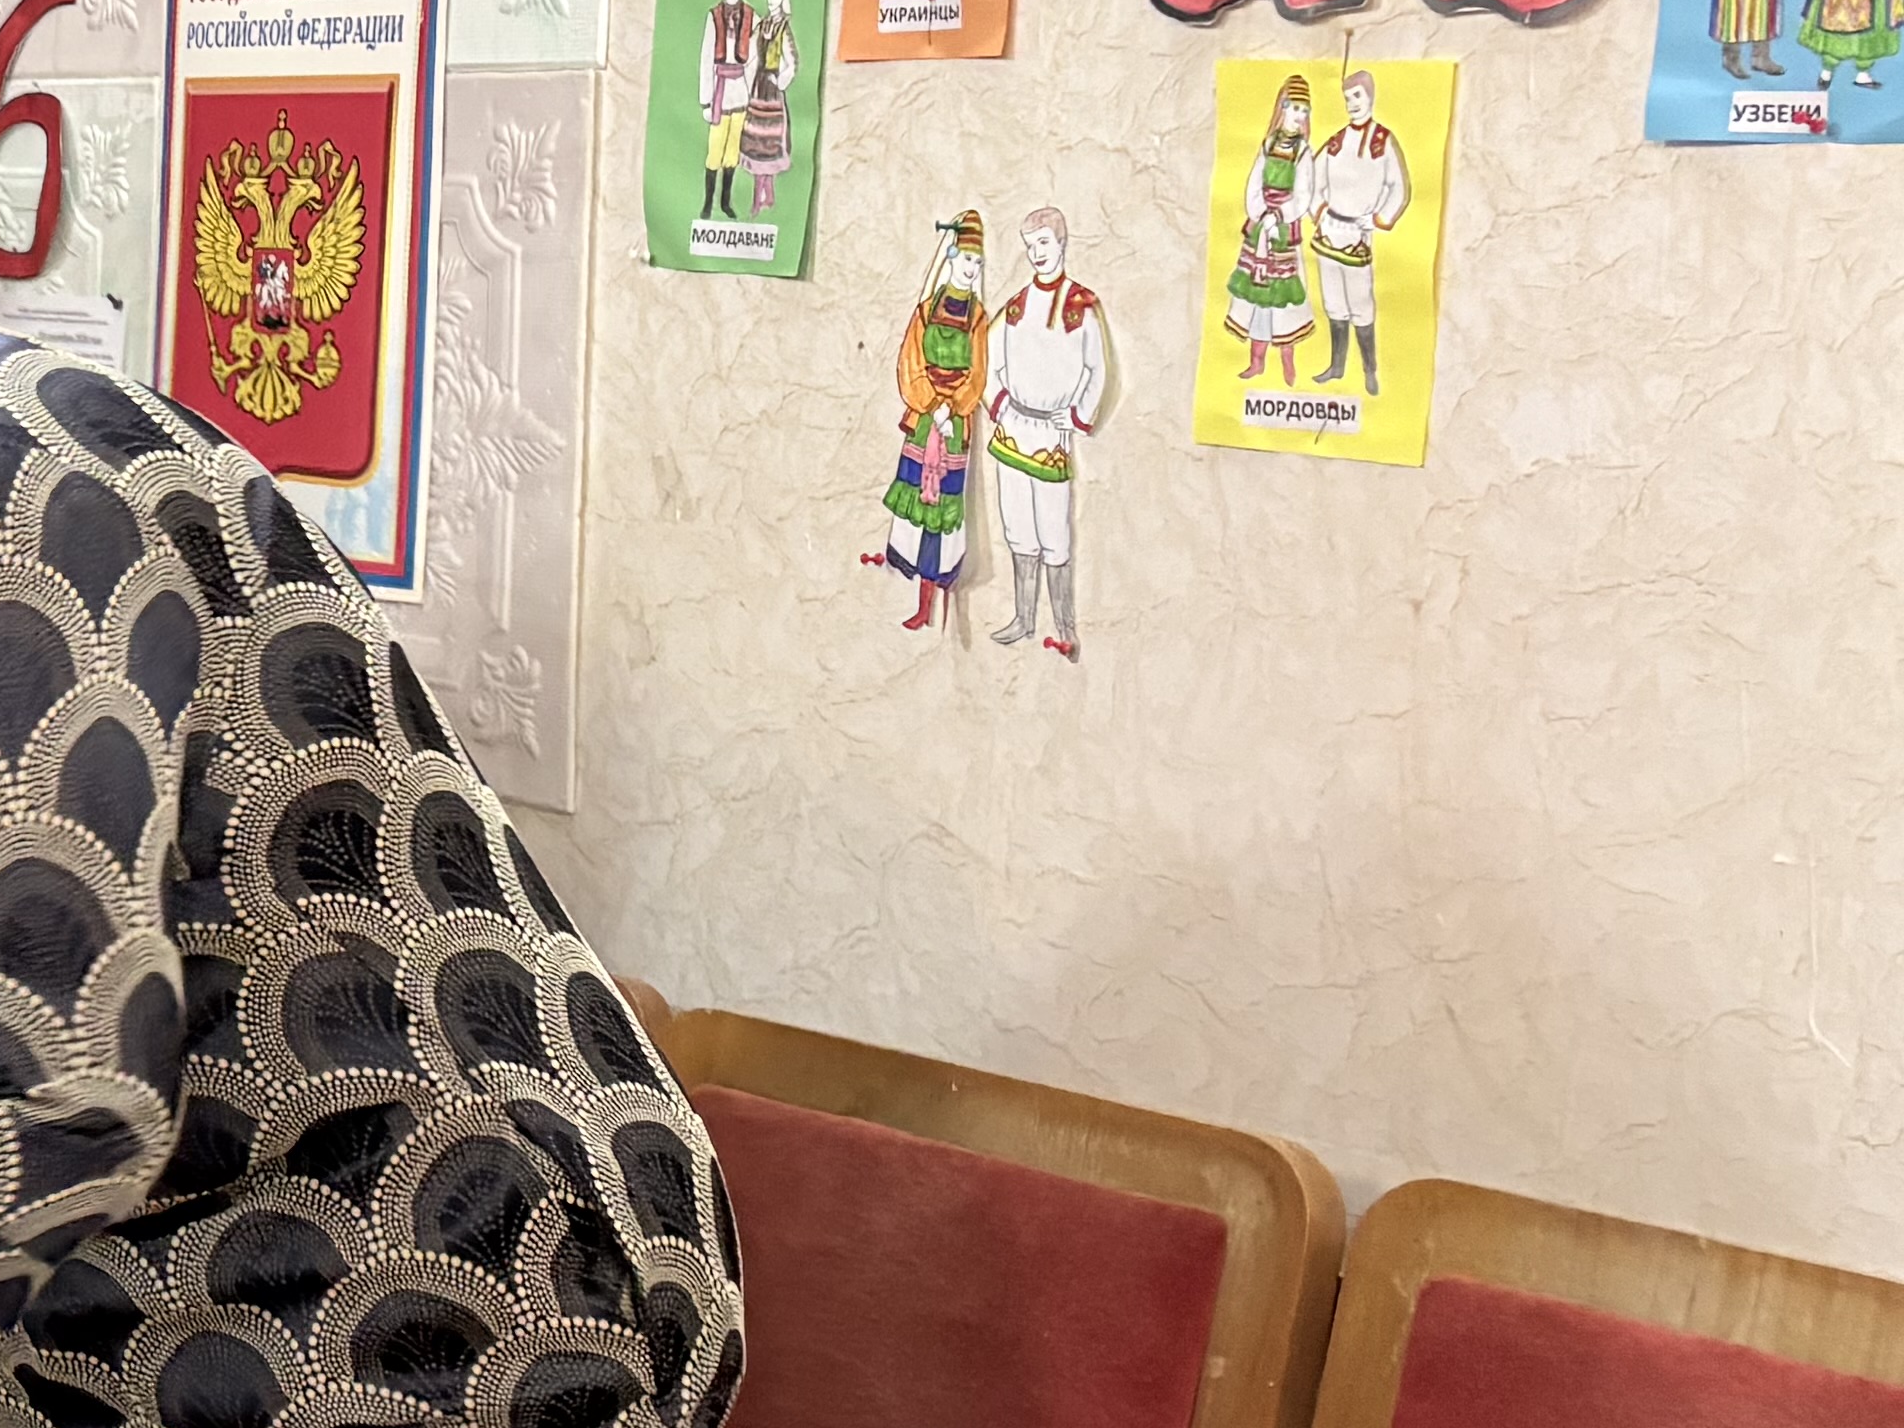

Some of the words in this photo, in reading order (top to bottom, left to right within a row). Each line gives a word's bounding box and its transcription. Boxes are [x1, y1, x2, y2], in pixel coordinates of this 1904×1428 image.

[879, 3, 960, 24] УКРАИНЦЫ
[186, 8, 293, 49] РОССИЙСКОЙ
[296, 14, 404, 50] ФЕДЕРАЦИИ
[691, 227, 776, 249] МОЛДАВАНЕ
[1244, 398, 1357, 424] МОРДОВЦЫ
